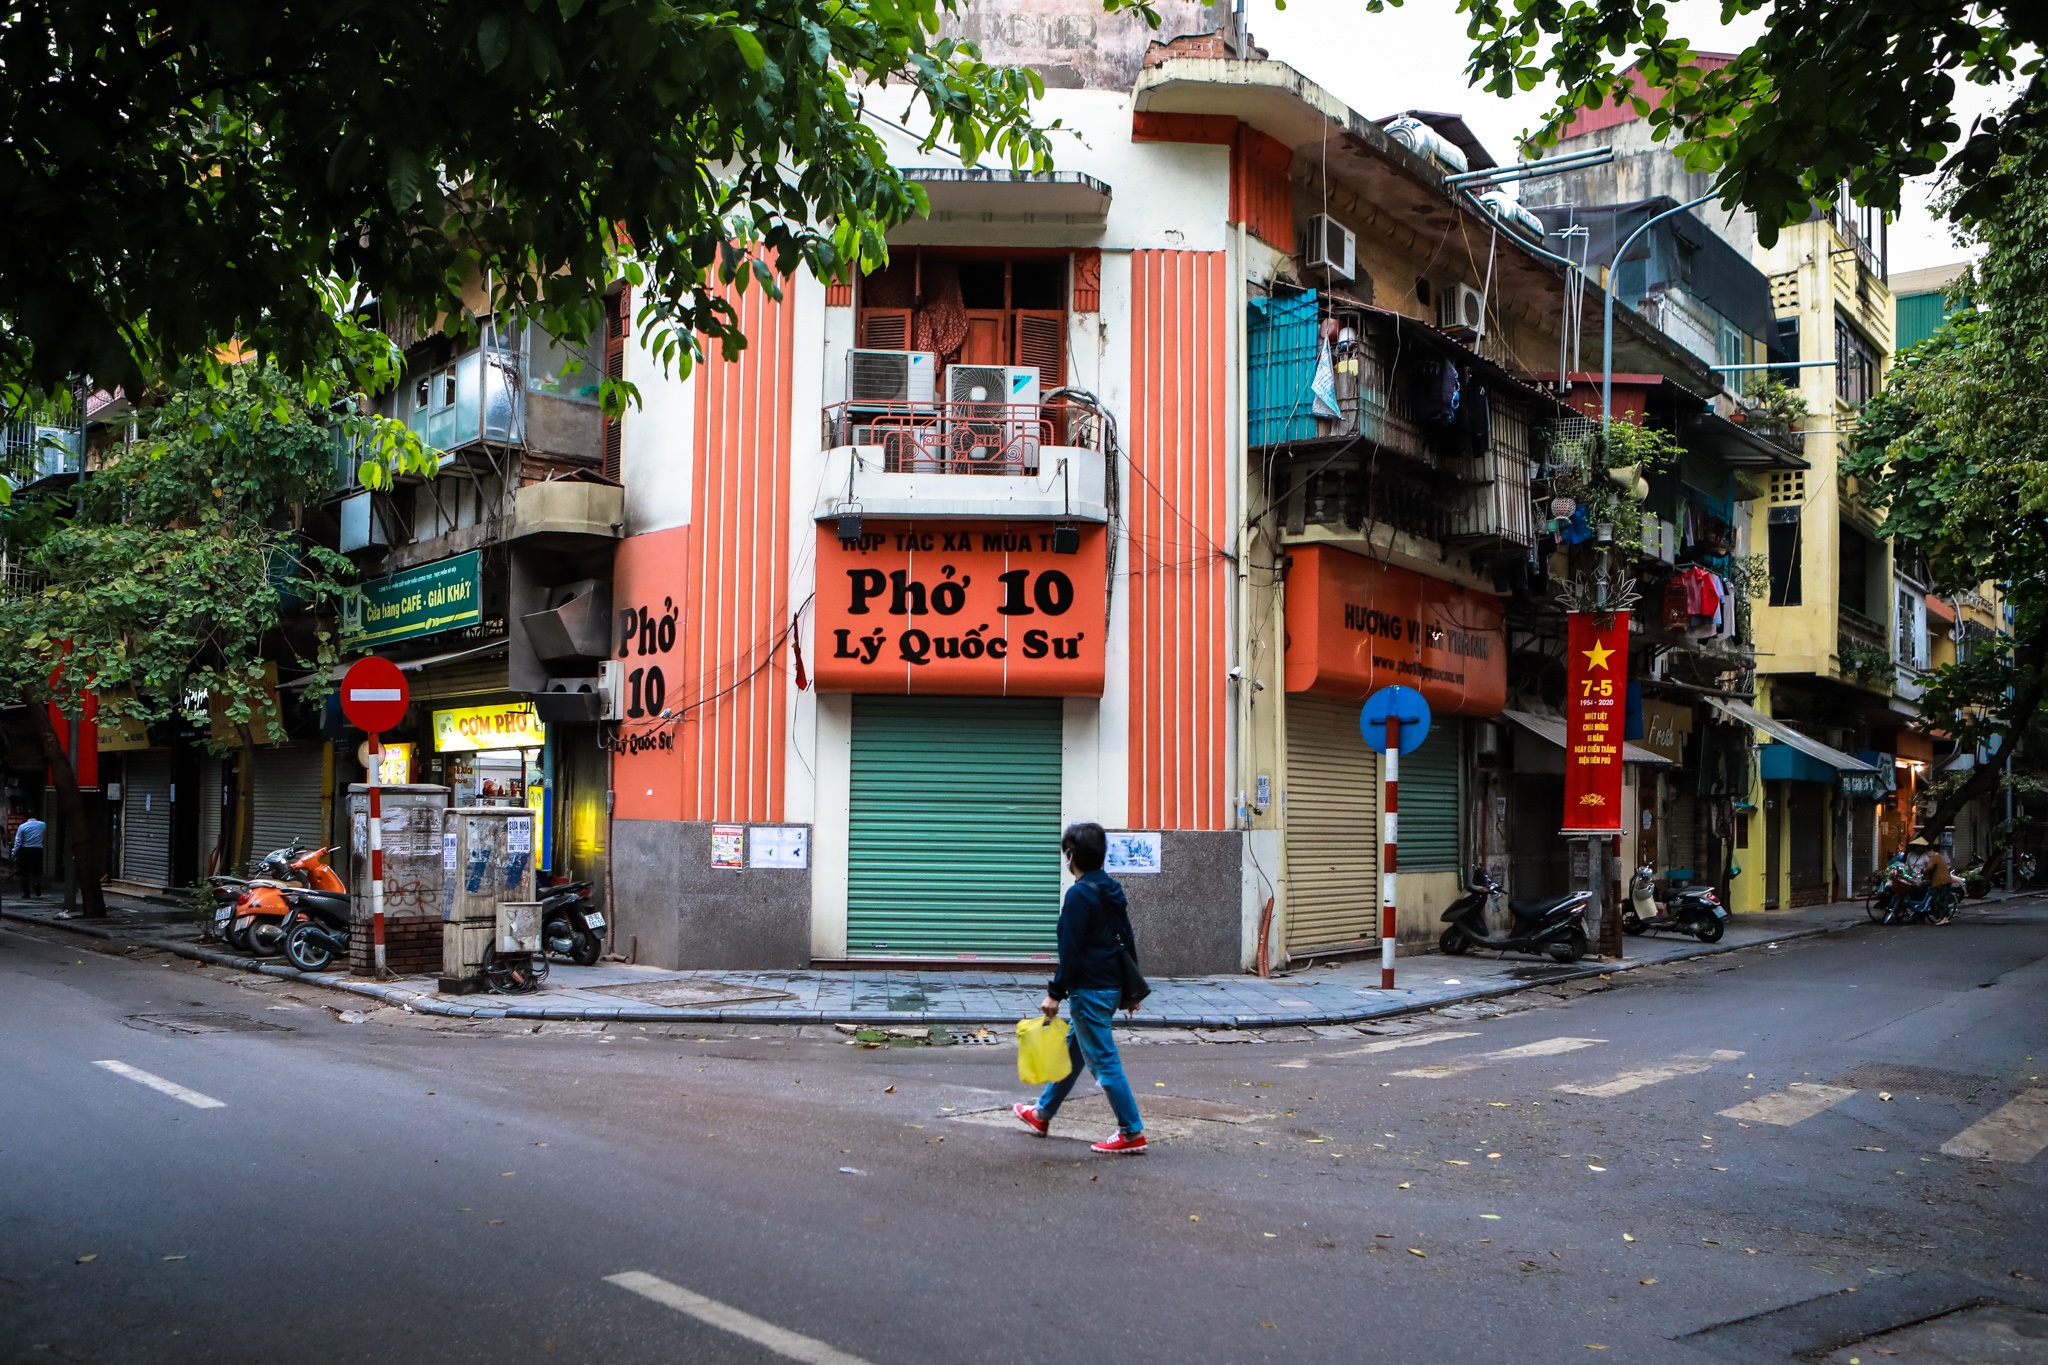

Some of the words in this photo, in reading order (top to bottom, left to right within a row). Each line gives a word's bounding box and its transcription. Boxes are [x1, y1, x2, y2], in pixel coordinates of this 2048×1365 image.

[401, 589, 422, 614] CAFÉ
[428, 582, 446, 608] GIẢI
[447, 577, 472, 603] KHÁT
[846, 564, 971, 616] Phở
[997, 569, 1074, 616] 10
[618, 596, 679, 658] Phở
[1344, 602, 1402, 641] HƯƠNG
[833, 627, 887, 665] Lý
[898, 623, 1008, 665] Quốc
[1022, 629, 1085, 659] Sư
[627, 665, 666, 719] 10
[1581, 679, 1613, 697] 7-5
[459, 715, 491, 736] CƠM
